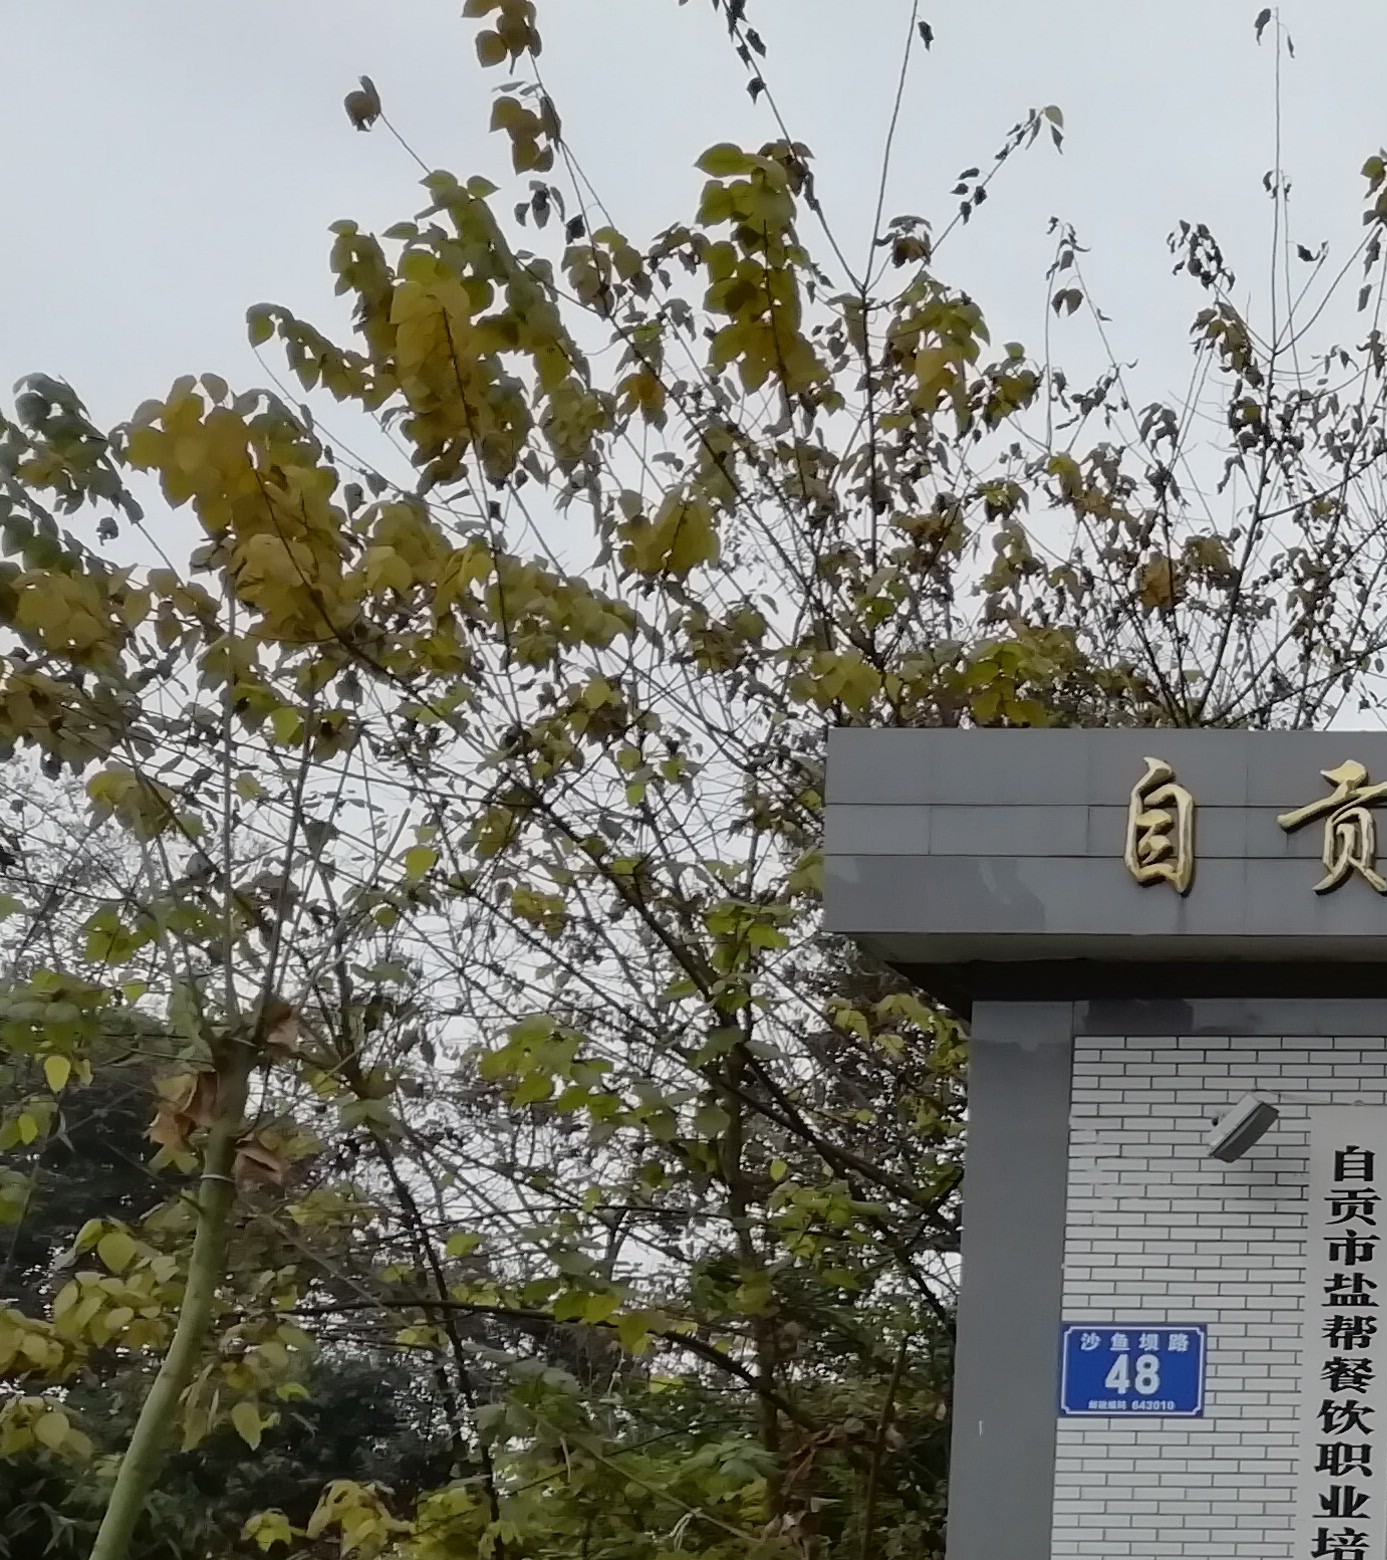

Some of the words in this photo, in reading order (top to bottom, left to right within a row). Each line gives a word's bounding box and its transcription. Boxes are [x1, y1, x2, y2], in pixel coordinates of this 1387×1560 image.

[1080, 1332, 1189, 1352] 沙鱼坝路
[1104, 1353, 1161, 1395] 48
[1131, 1400, 1176, 1410] 643010
